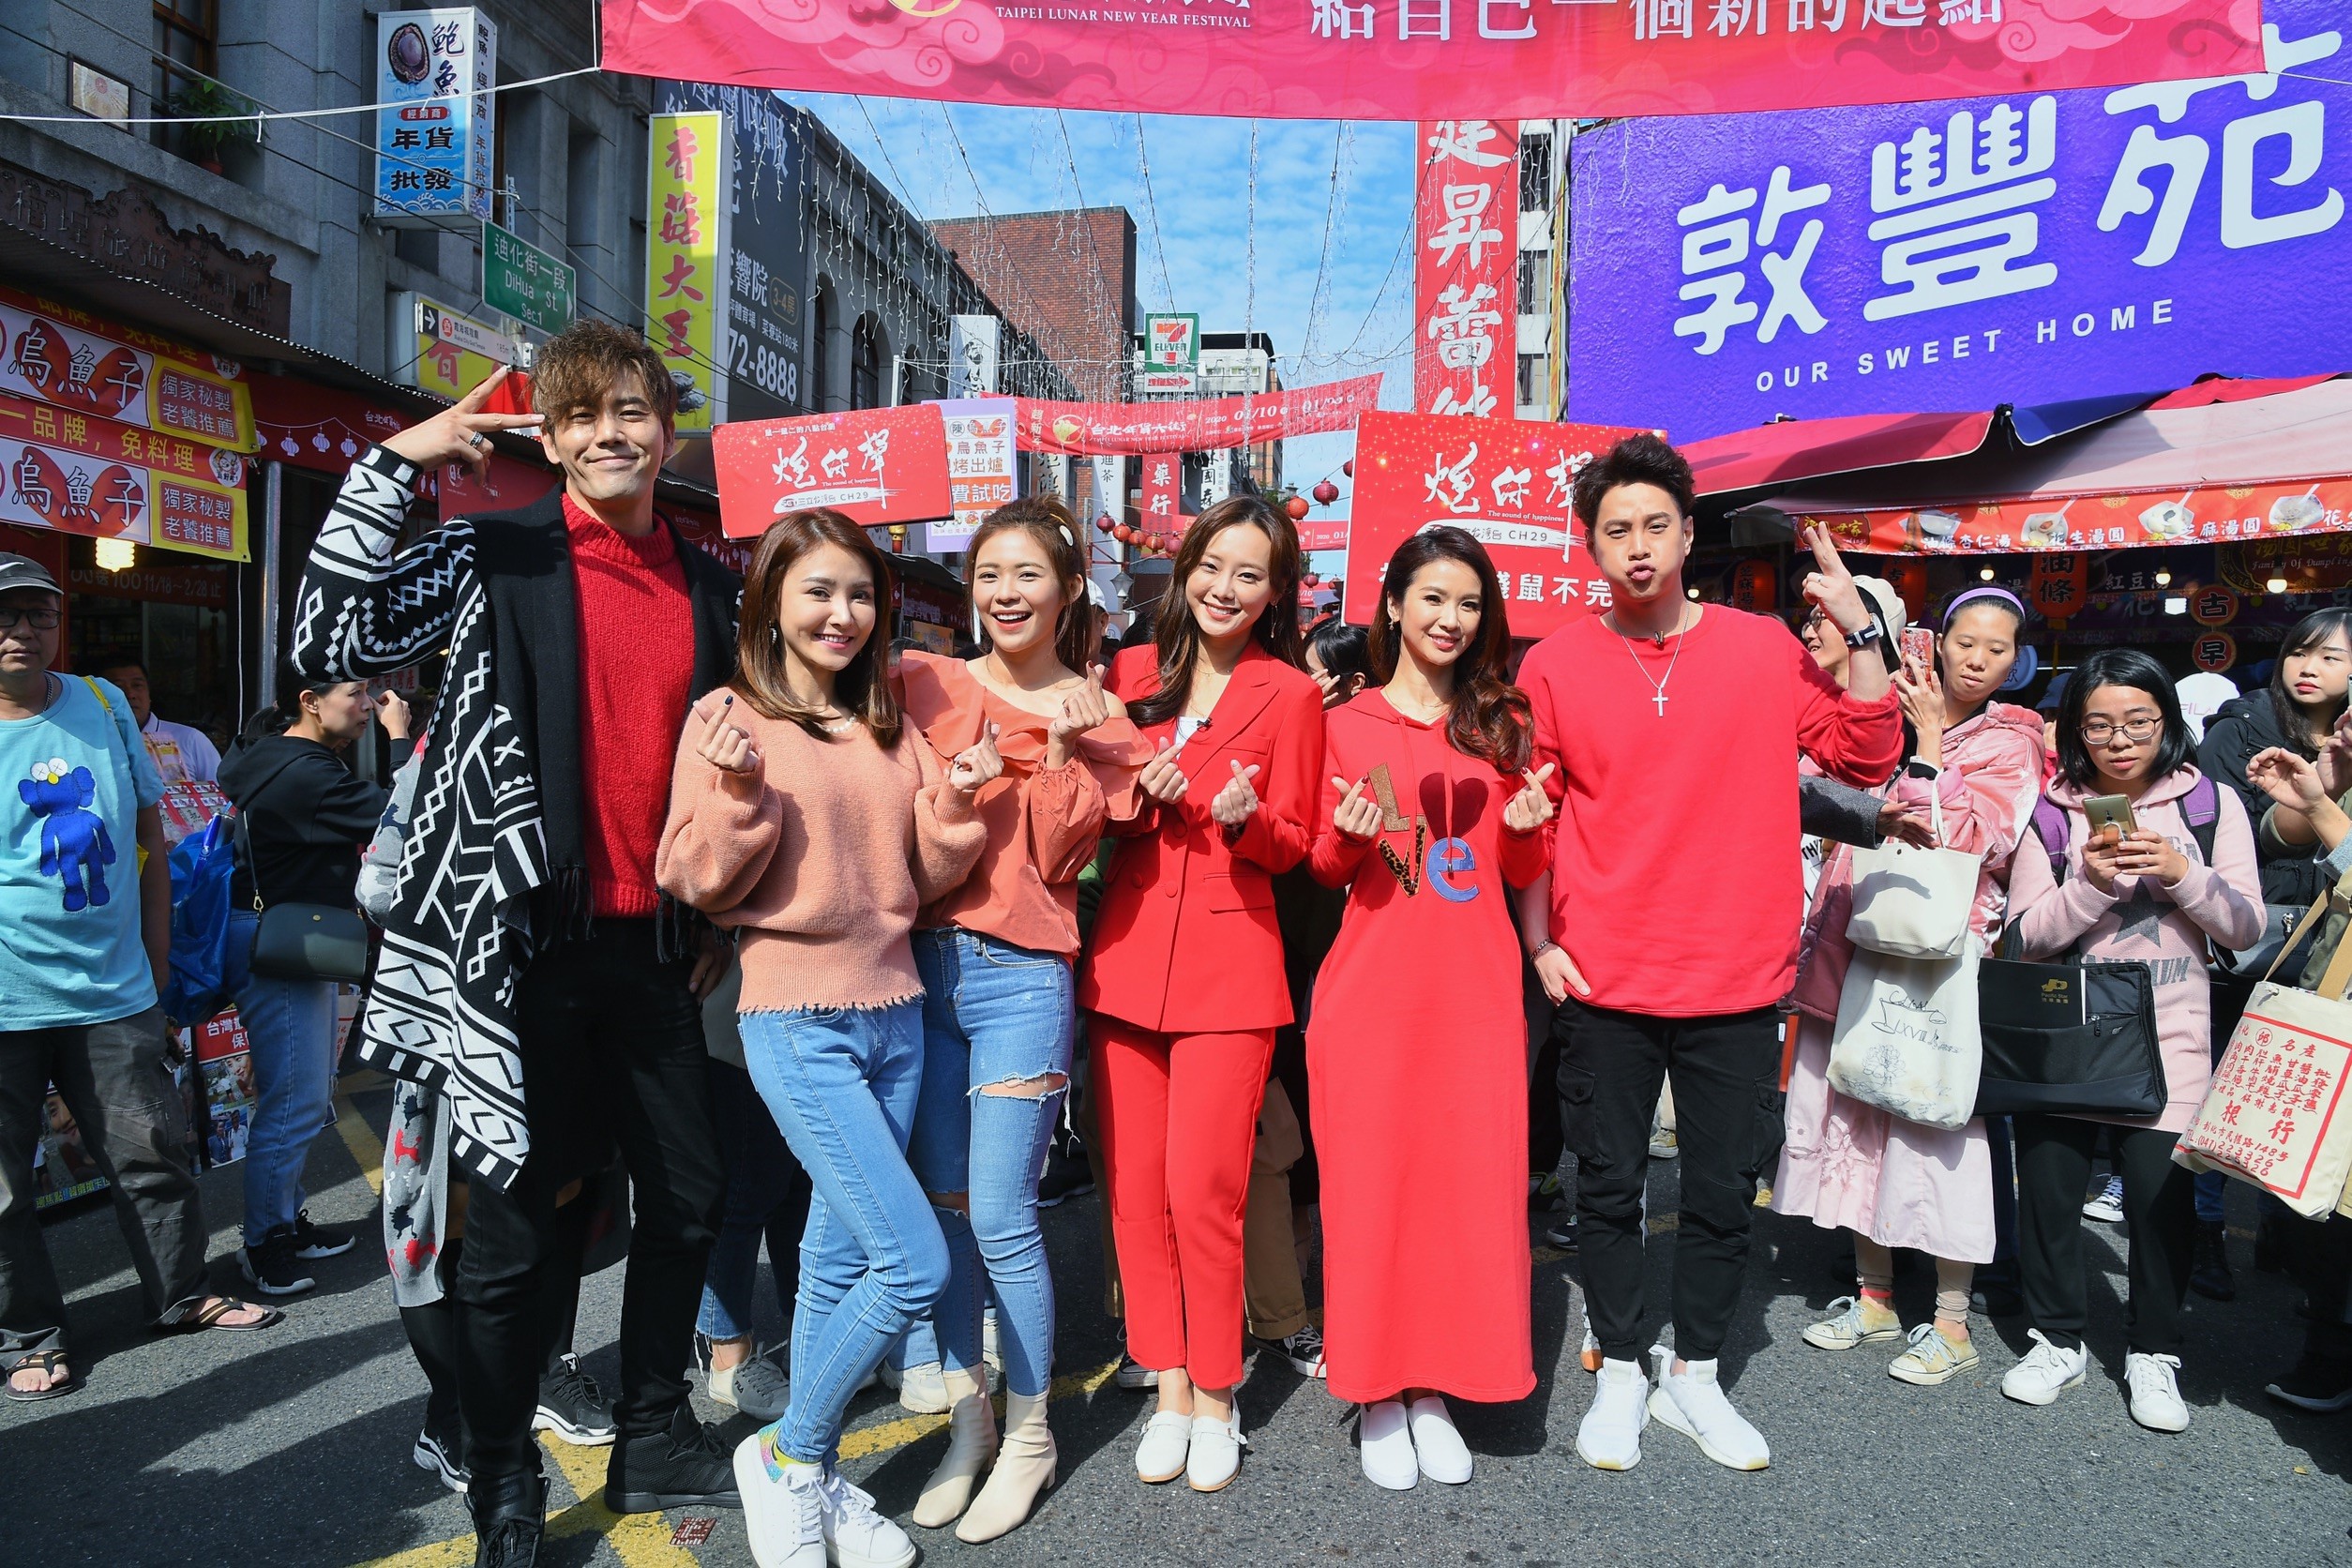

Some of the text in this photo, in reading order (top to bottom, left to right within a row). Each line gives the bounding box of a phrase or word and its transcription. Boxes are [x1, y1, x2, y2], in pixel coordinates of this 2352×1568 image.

[995, 6, 1252, 28] TAIPEI LUNAR NEW YEAR FESTIVAL
[431, 20, 465, 98] 鮑魚
[390, 126, 455, 151] 年貨
[390, 167, 455, 192] 批發
[1674, 23, 2344, 356] 敦豐苑
[658, 126, 704, 359] 香菇大王
[494, 234, 566, 293] 迪化街一段
[505, 269, 535, 300] DiHua
[520, 302, 543, 325] Sec.1
[1756, 298, 2174, 394] OUR SWEET HOME
[8, 327, 143, 410] 烏魚子
[161, 374, 233, 413] 獨家秘製
[957, 440, 1005, 456] 烏魚子
[947, 457, 1004, 475] 烤出爐
[12, 454, 147, 527] 烏魚子
[839, 490, 869, 502] CH29
[952, 483, 1012, 504] 費試吃
[163, 487, 232, 522] 獨家秘製
[1487, 509, 1565, 522] The sound of happiness
[1508, 530, 1548, 543] CH29
[2048, 526, 2126, 547] 花生湯圓
[2180, 517, 2262, 541] 芝麻湯圓
